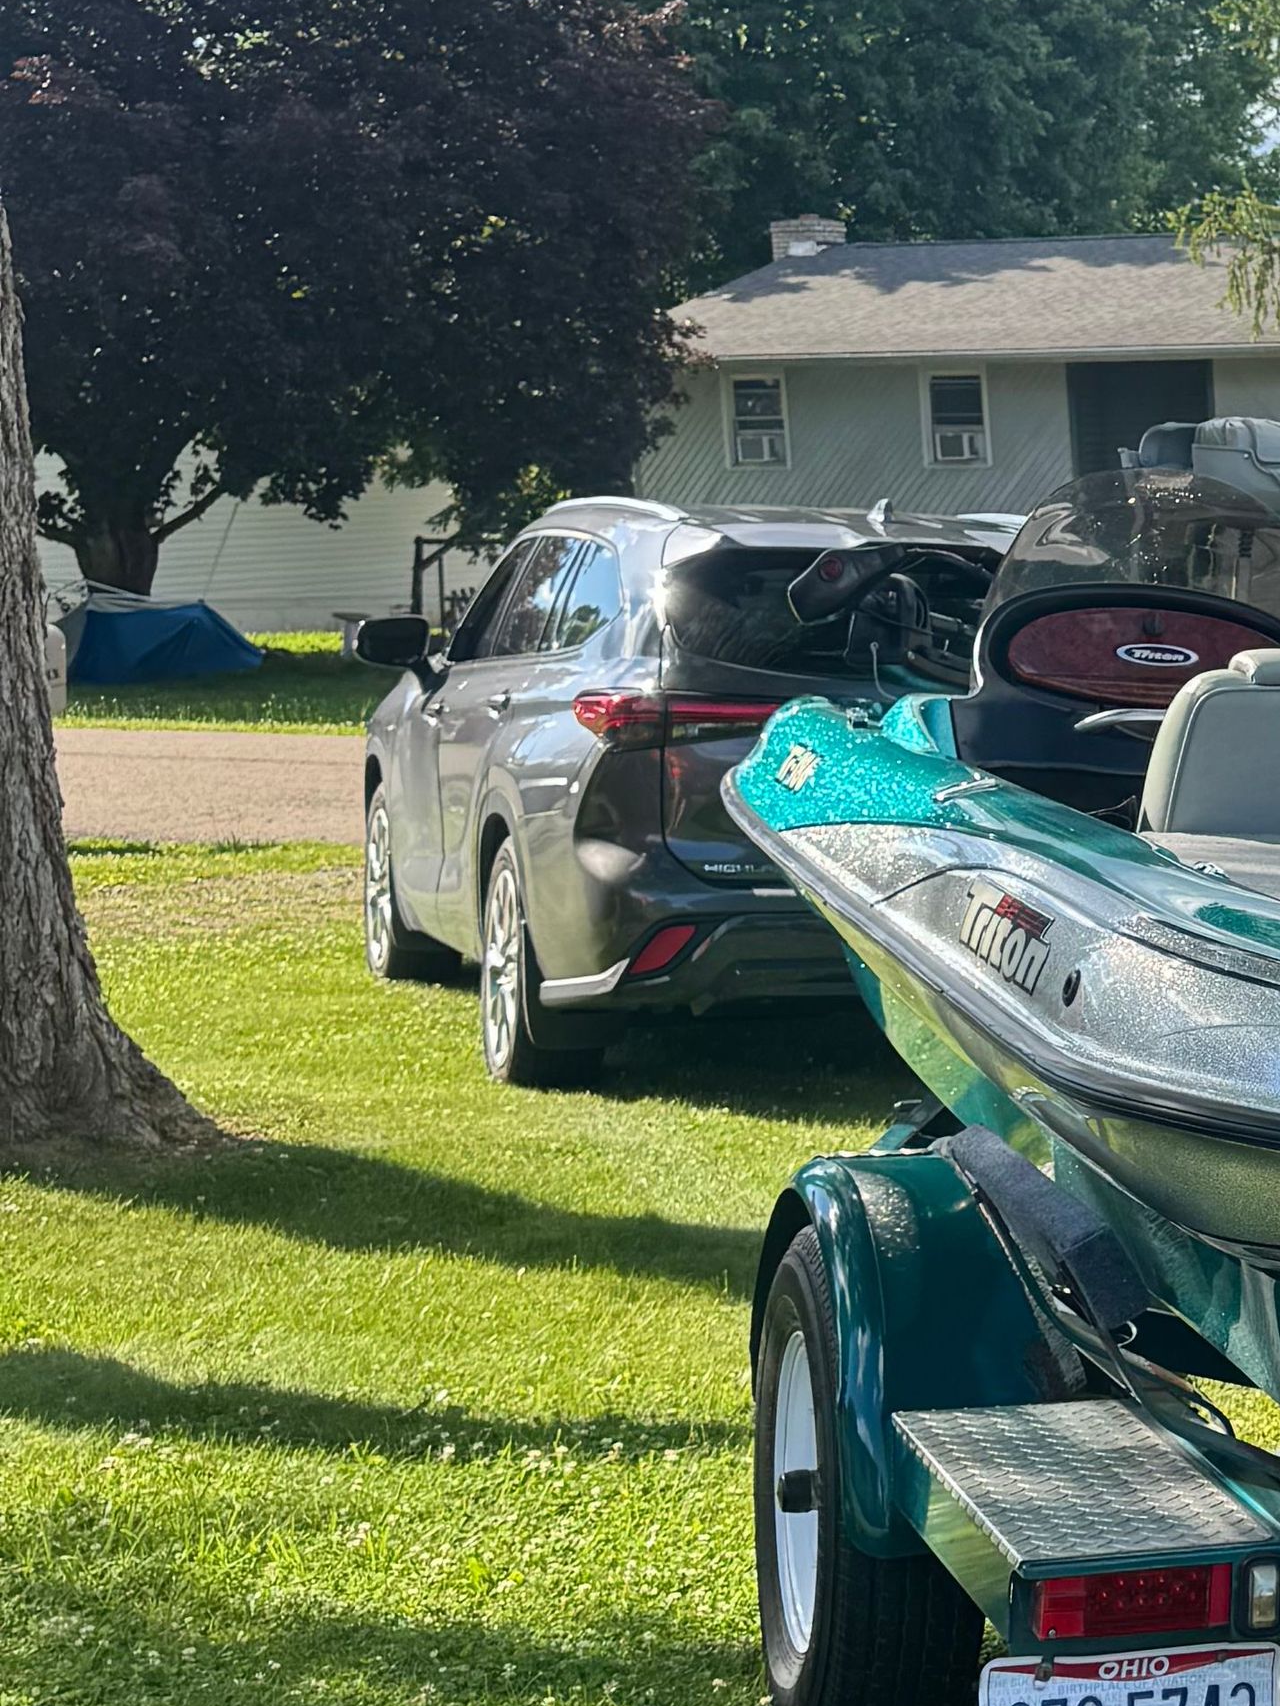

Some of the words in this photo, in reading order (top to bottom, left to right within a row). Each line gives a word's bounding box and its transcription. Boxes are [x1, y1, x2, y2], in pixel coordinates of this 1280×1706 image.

[1131, 649, 1185, 662] Triton
[959, 874, 1052, 996] Triton
[1098, 1656, 1170, 1680] OHIO
[1058, 1680, 1131, 1695] BIRTHPLACE
[1152, 1672, 1207, 1687] AVIATION
